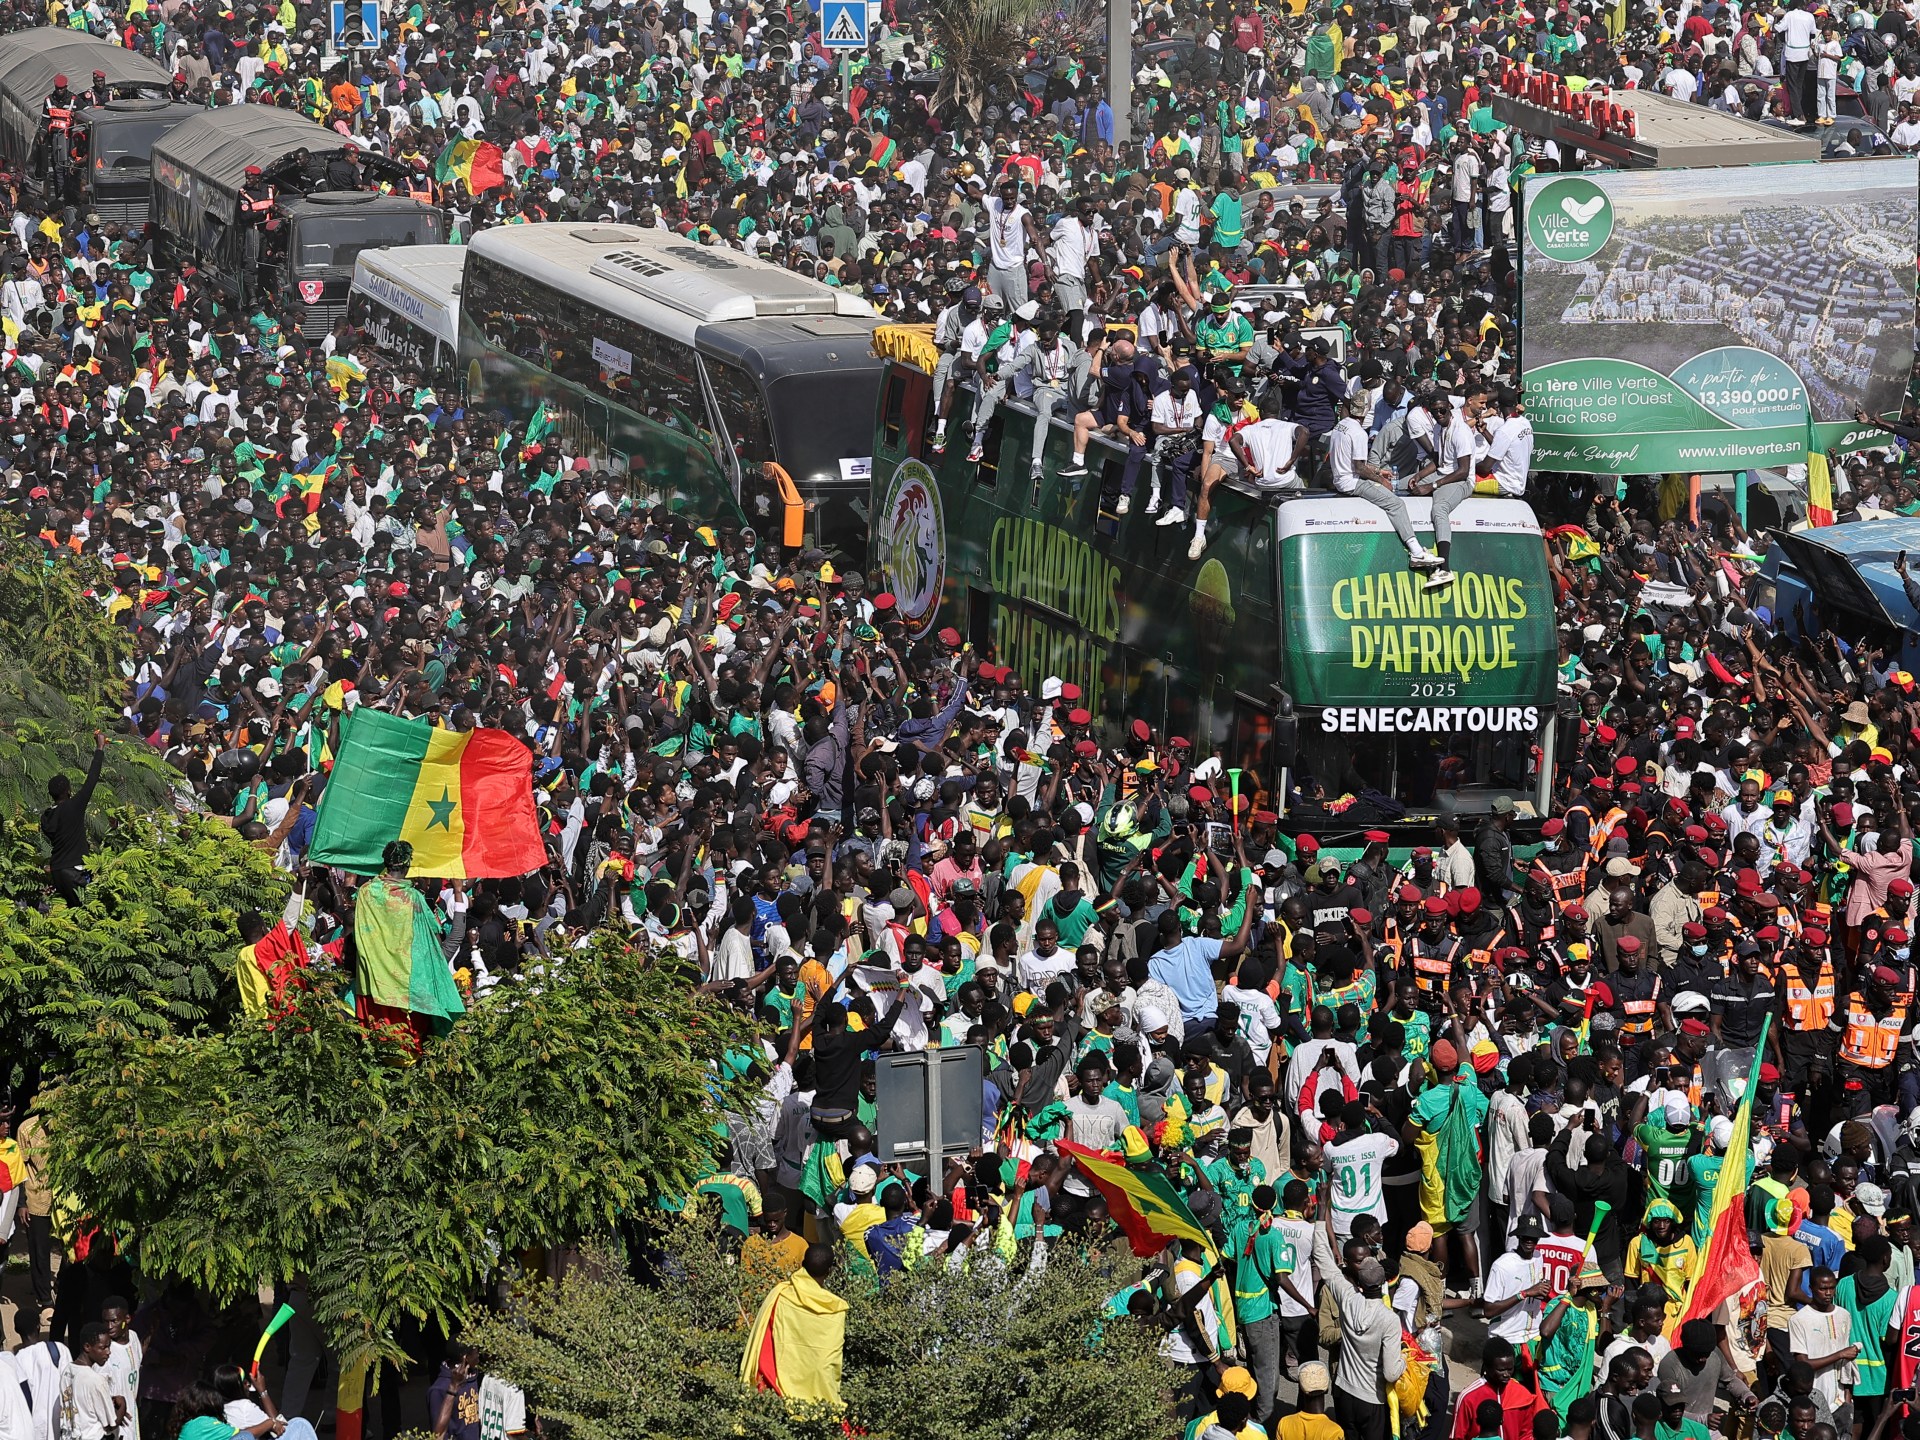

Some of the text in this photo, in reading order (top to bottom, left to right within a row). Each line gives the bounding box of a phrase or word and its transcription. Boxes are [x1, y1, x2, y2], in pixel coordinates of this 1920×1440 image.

[1538, 213, 1569, 228] Ville
[1543, 229, 1590, 243] Verte
[369, 275, 424, 320] SAMU NATIONAL
[1525, 376, 1658, 393] La 1ère Ville Verte
[1688, 373, 1699, 385] à
[1700, 366, 1746, 390] partir
[1750, 366, 1771, 383] de
[1524, 392, 1673, 411] d’Afrique de l’Ouest
[1699, 387, 1801, 407] 13,390,000 F
[1524, 411, 1617, 424] au Lac Rose
[1732, 403, 1801, 416] pour un studio
[1531, 444, 1640, 469] oyau du Sénégal
[1678, 440, 1801, 458] www.villeverte.sn
[991, 517, 1121, 642] CHAMPIONS
[1331, 570, 1527, 621] CHAMPIONS
[1350, 624, 1518, 683] D'AFRIQUE
[1410, 683, 1457, 698] 2025
[1321, 706, 1539, 733] SENECARTOURS
[1414, 959, 1449, 972] POLICE
[1332, 1151, 1376, 1164] PRINCE ISSA
[1340, 1163, 1371, 1198] 01
[1658, 1158, 1688, 1185] 00
[1238, 1192, 1249, 1206] 10
[1539, 1248, 1573, 1263] PIOCHE
